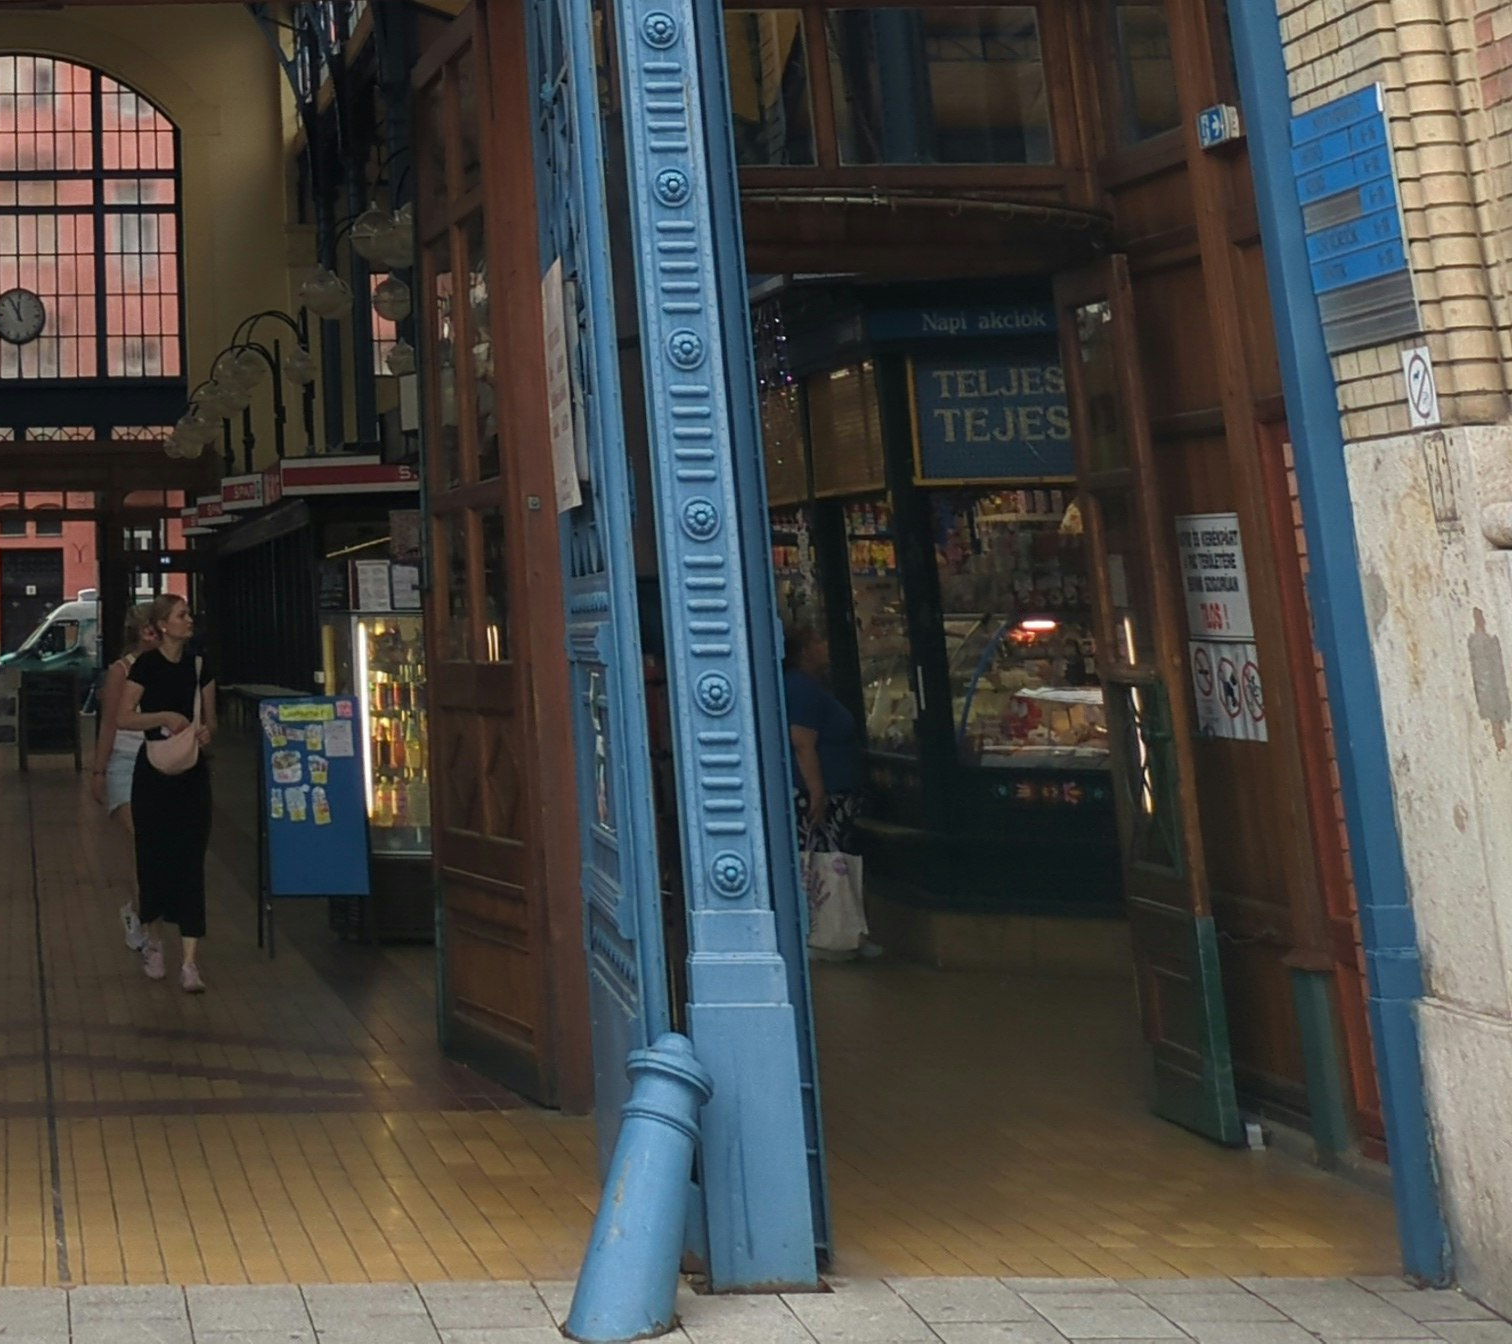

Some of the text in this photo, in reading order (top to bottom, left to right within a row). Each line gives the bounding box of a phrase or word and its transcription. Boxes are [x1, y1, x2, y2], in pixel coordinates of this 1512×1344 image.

[921, 312, 968, 335] Napi
[932, 365, 1067, 398] TELJES
[933, 405, 1073, 443] TEJES
